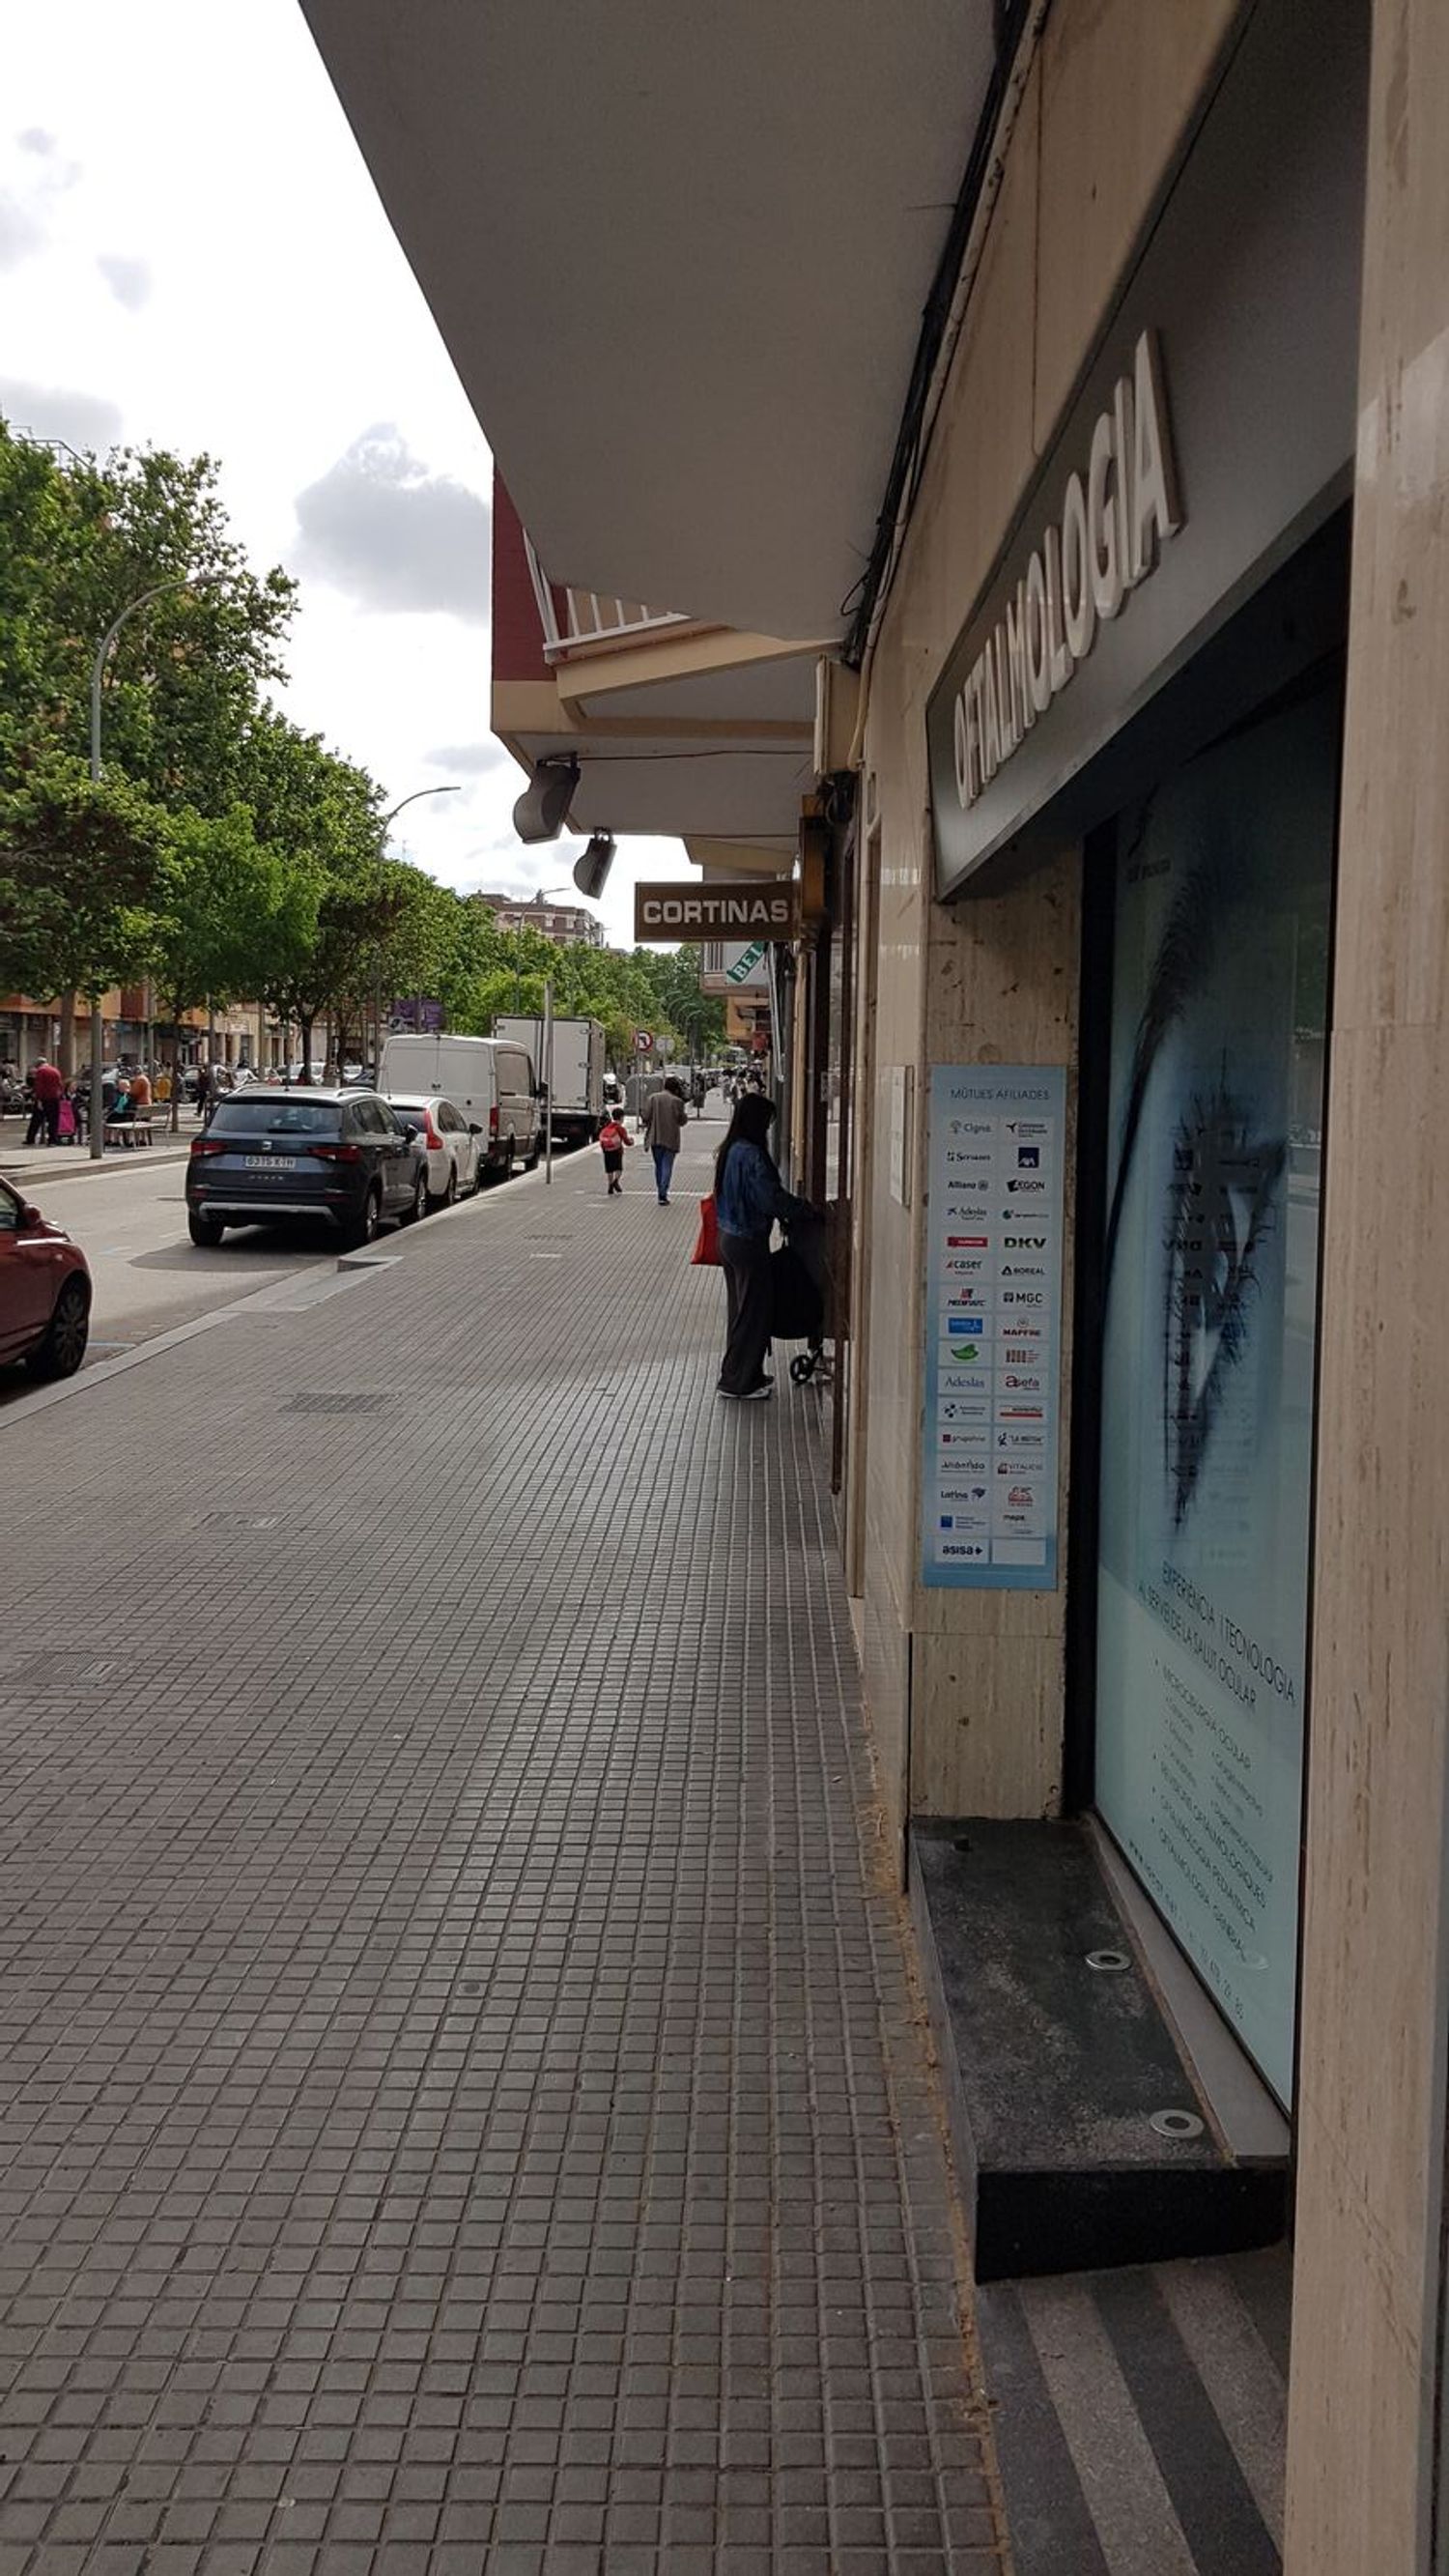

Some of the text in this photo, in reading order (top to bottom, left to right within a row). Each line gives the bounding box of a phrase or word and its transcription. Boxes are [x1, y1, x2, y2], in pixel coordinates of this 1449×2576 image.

[954, 328, 1182, 810] OFTALMOLOGIA
[643, 900, 788, 924] CORTINAS
[996, 1088, 1051, 1102] AFILIADES
[1004, 1238, 1046, 1248] DKV
[954, 1260, 982, 1270] caser
[1016, 1293, 1043, 1303] MGC
[942, 1546, 975, 1556] asisa
